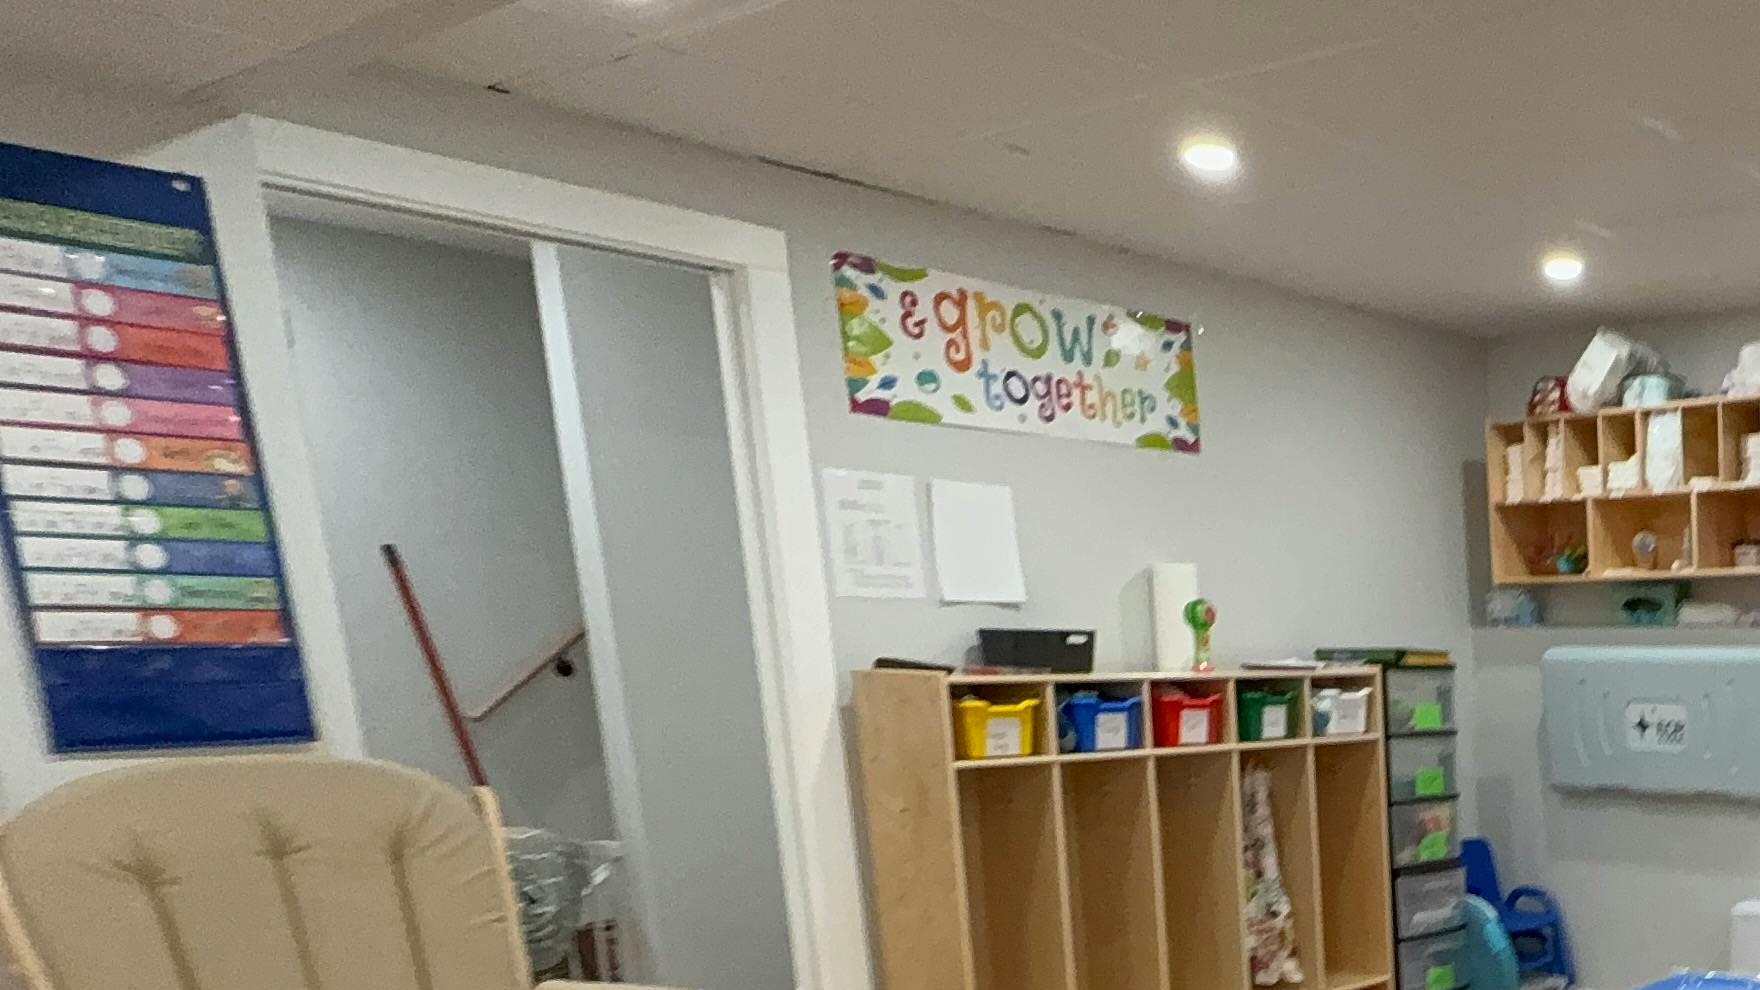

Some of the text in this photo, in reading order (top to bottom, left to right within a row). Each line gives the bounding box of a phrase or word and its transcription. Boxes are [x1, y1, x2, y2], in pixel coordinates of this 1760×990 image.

[900, 287, 1097, 374] & grow
[976, 357, 1157, 428] together
